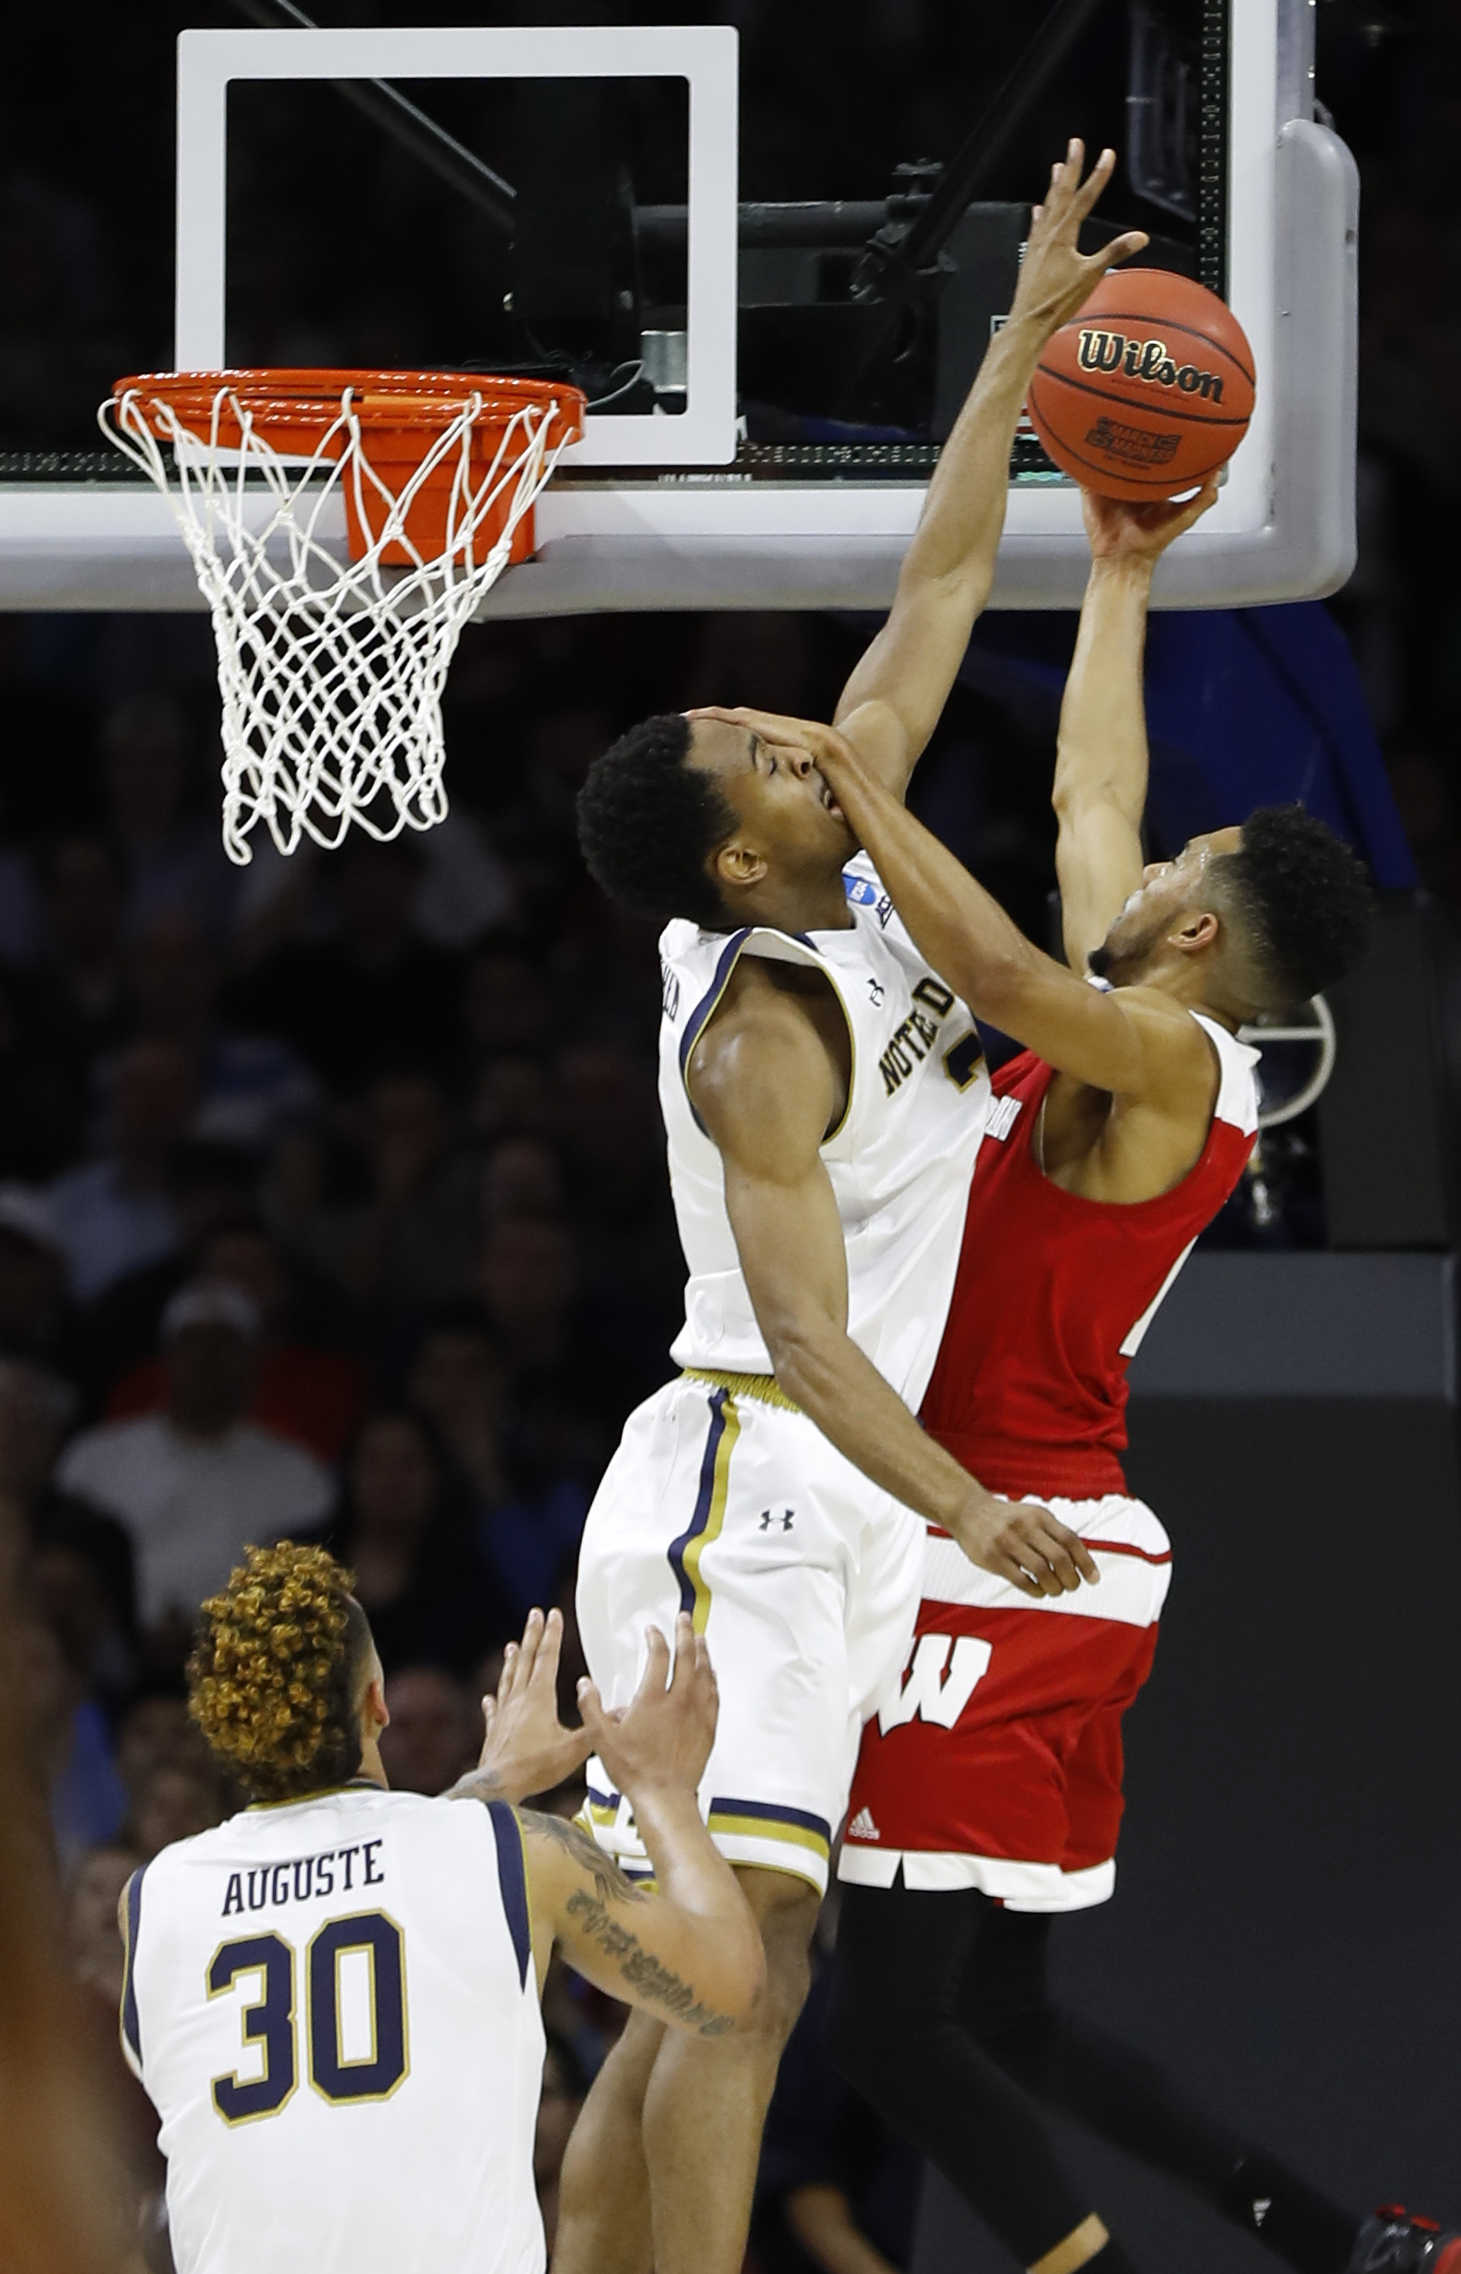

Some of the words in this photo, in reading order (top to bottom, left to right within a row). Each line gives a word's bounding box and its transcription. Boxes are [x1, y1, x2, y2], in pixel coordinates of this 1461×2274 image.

[1077, 330, 1224, 404] Wilson
[878, 1009, 940, 1098] NOTE
[877, 1632, 993, 1739] W
[221, 1838, 385, 1918] AUGUSTE
[204, 1907, 411, 2129] 30
